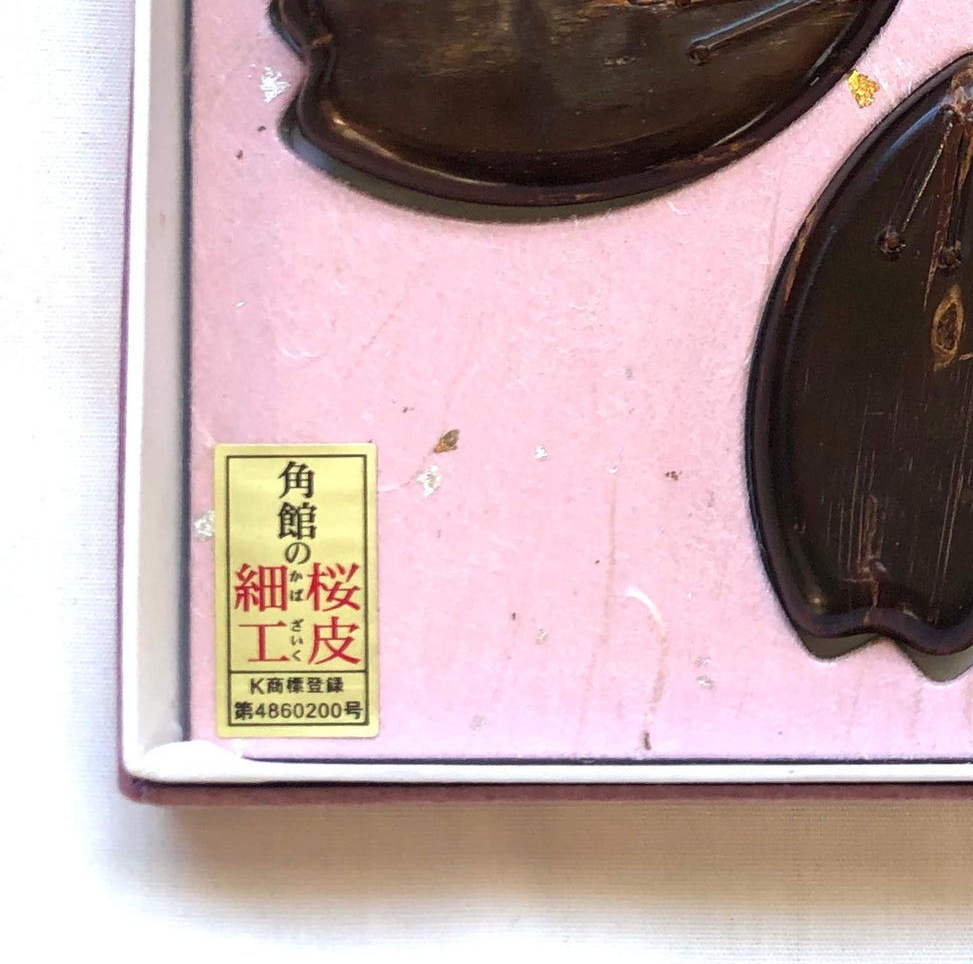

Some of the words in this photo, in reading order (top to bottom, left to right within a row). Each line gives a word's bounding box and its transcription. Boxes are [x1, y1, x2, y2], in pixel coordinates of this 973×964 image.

[278, 460, 318, 565] 角館の
[233, 562, 290, 663] 細工
[306, 562, 361, 665] 桜皮
[234, 700, 363, 721] 第4860200号
[250, 675, 345, 695] K商標登録
